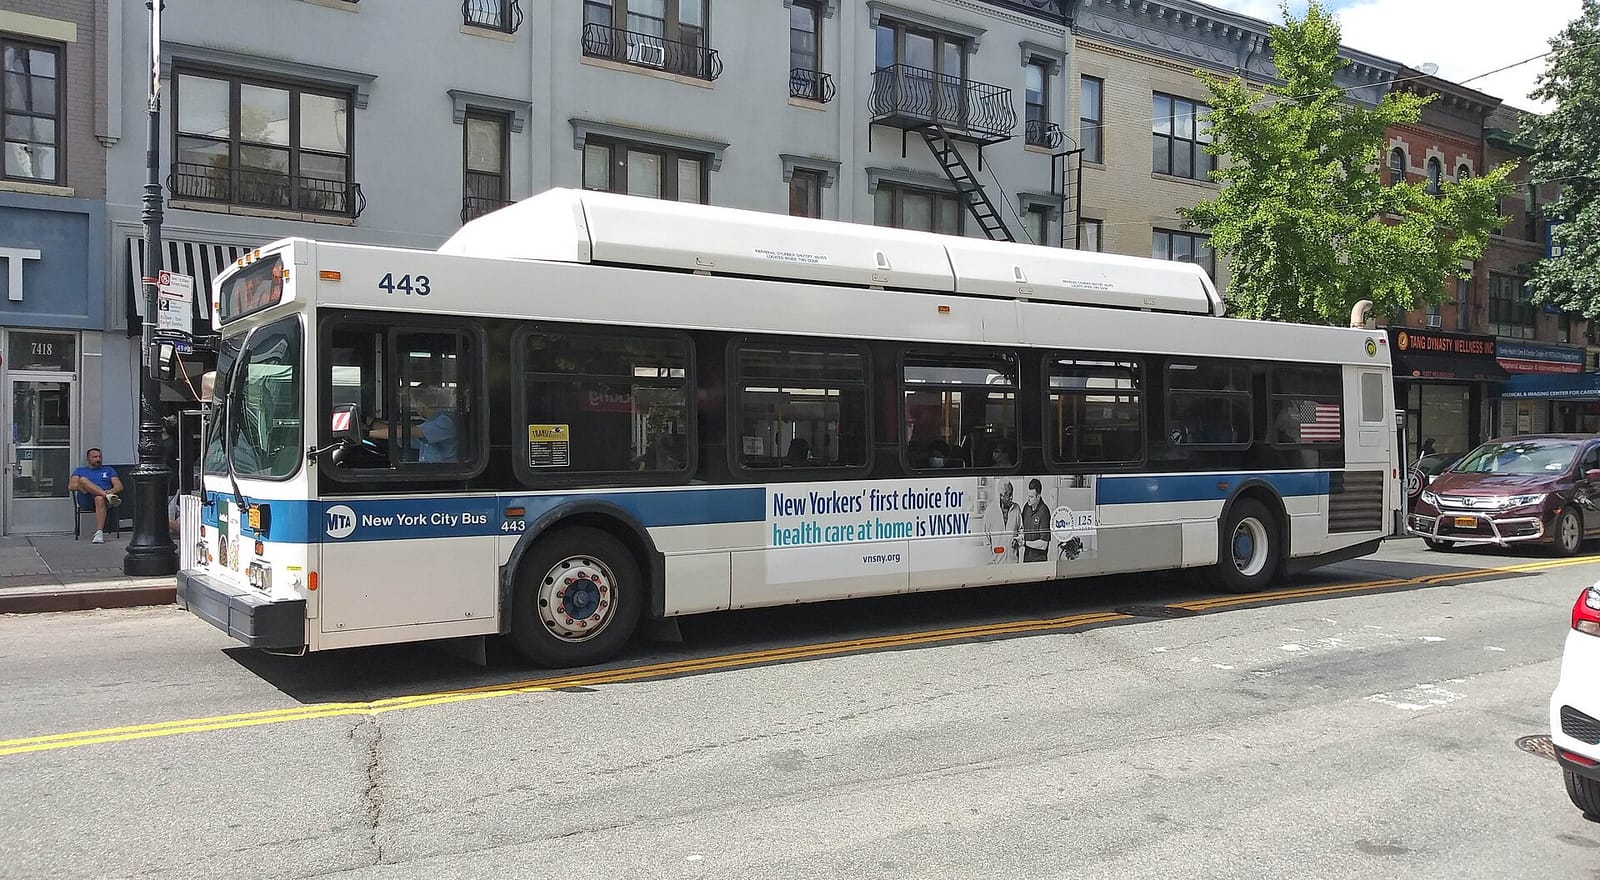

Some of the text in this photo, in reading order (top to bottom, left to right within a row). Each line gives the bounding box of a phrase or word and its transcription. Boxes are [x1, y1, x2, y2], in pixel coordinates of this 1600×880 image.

[378, 272, 431, 296] 443
[31, 342, 52, 356] 7418
[1410, 335, 1426, 350] TANG
[1427, 337, 1453, 352] DYNASTY
[1455, 339, 1483, 354] WELLNESS
[1484, 342, 1494, 354] INC
[773, 486, 964, 517] New Yorkers' first choice for
[326, 512, 351, 531] MTA
[362, 512, 487, 527] New York City Bus
[500, 520, 526, 532] 443
[1077, 515, 1092, 526] 125
[773, 512, 971, 546] health care at home is VNSNY.
[862, 552, 901, 564] vnsny.org
